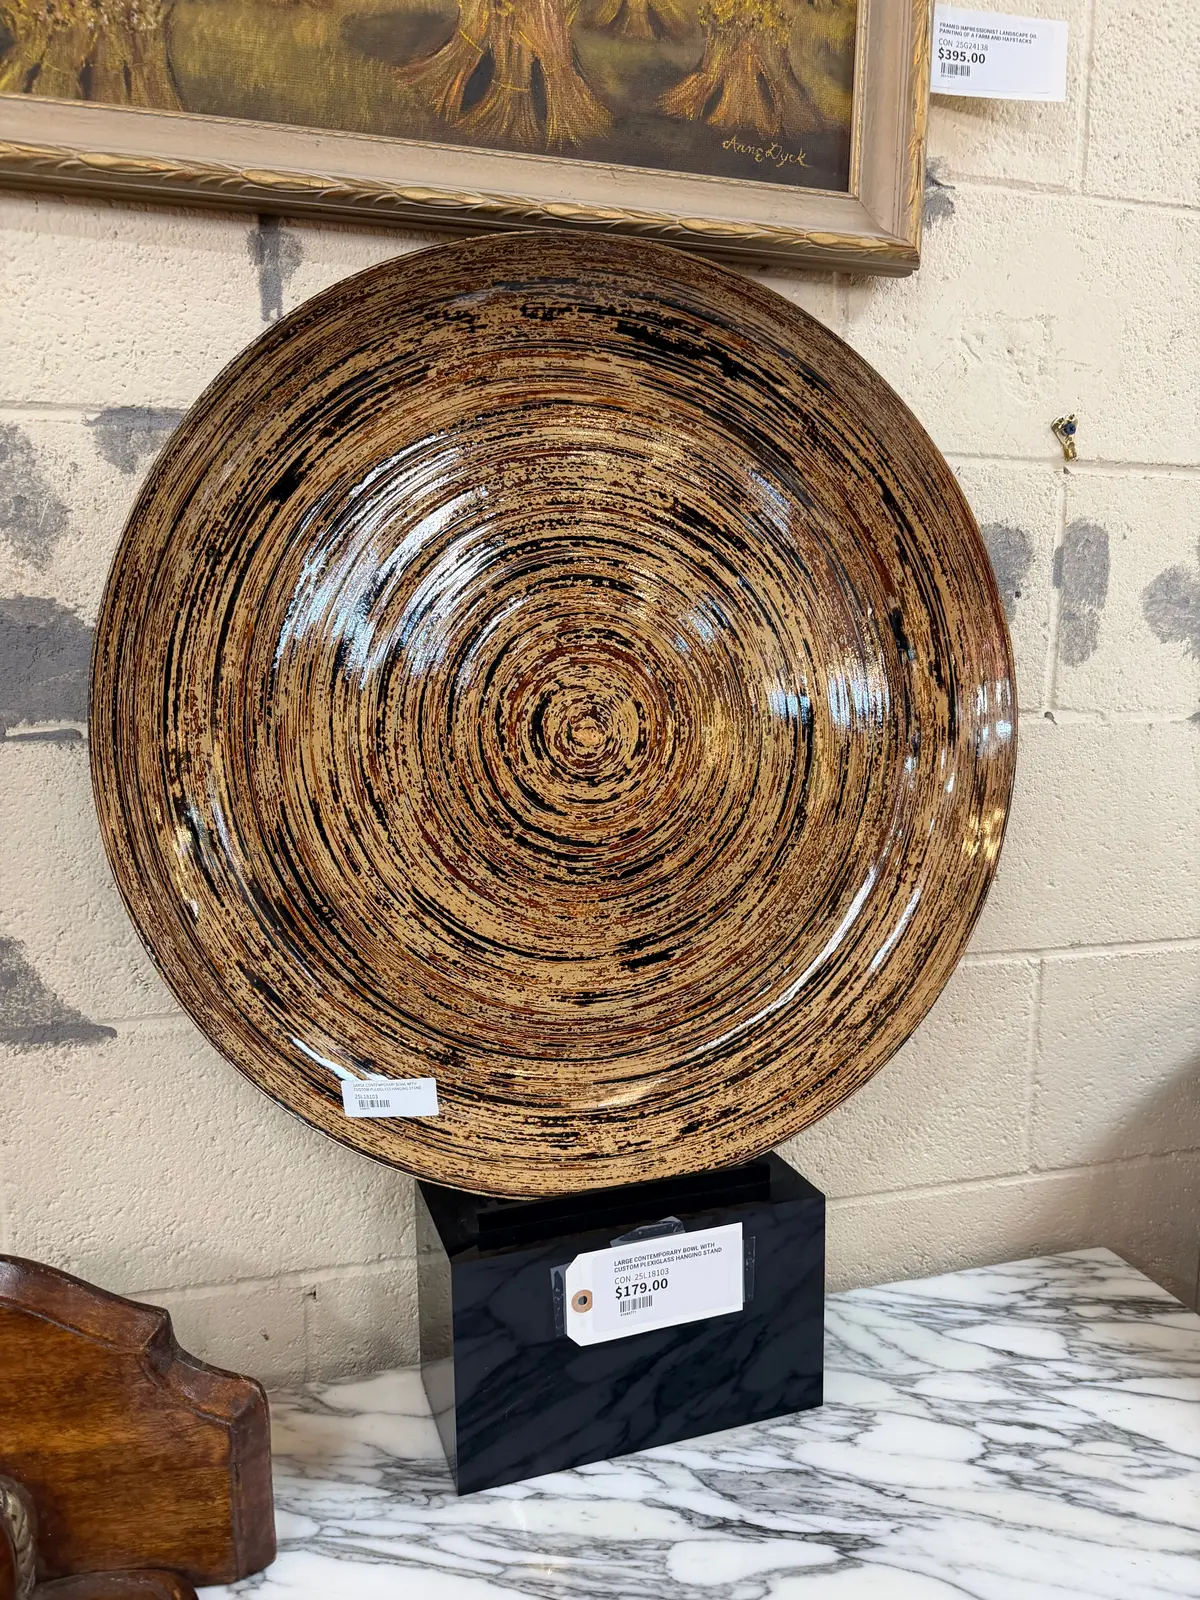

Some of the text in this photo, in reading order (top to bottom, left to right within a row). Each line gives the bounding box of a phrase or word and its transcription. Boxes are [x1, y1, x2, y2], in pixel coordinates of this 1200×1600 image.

[939, 22, 960, 30] FRAMED
[960, 25, 998, 35] IMPRESSIONIST
[999, 29, 1028, 39] LANDSCAPE
[939, 28, 963, 37] PAINTING
[1002, 36, 1032, 44] HAYSTACKS
[938, 38, 989, 52] CON 25G24138
[938, 47, 986, 64] $395.00
[614, 1242, 715, 1267] LARGE CONTEMPORARY BOWL WITH
[614, 1247, 723, 1273] CUSTOM PLEXIGLASS HANGING STAND
[614, 1267, 670, 1285] CON 25L18103
[615, 1278, 669, 1300] $179.00
